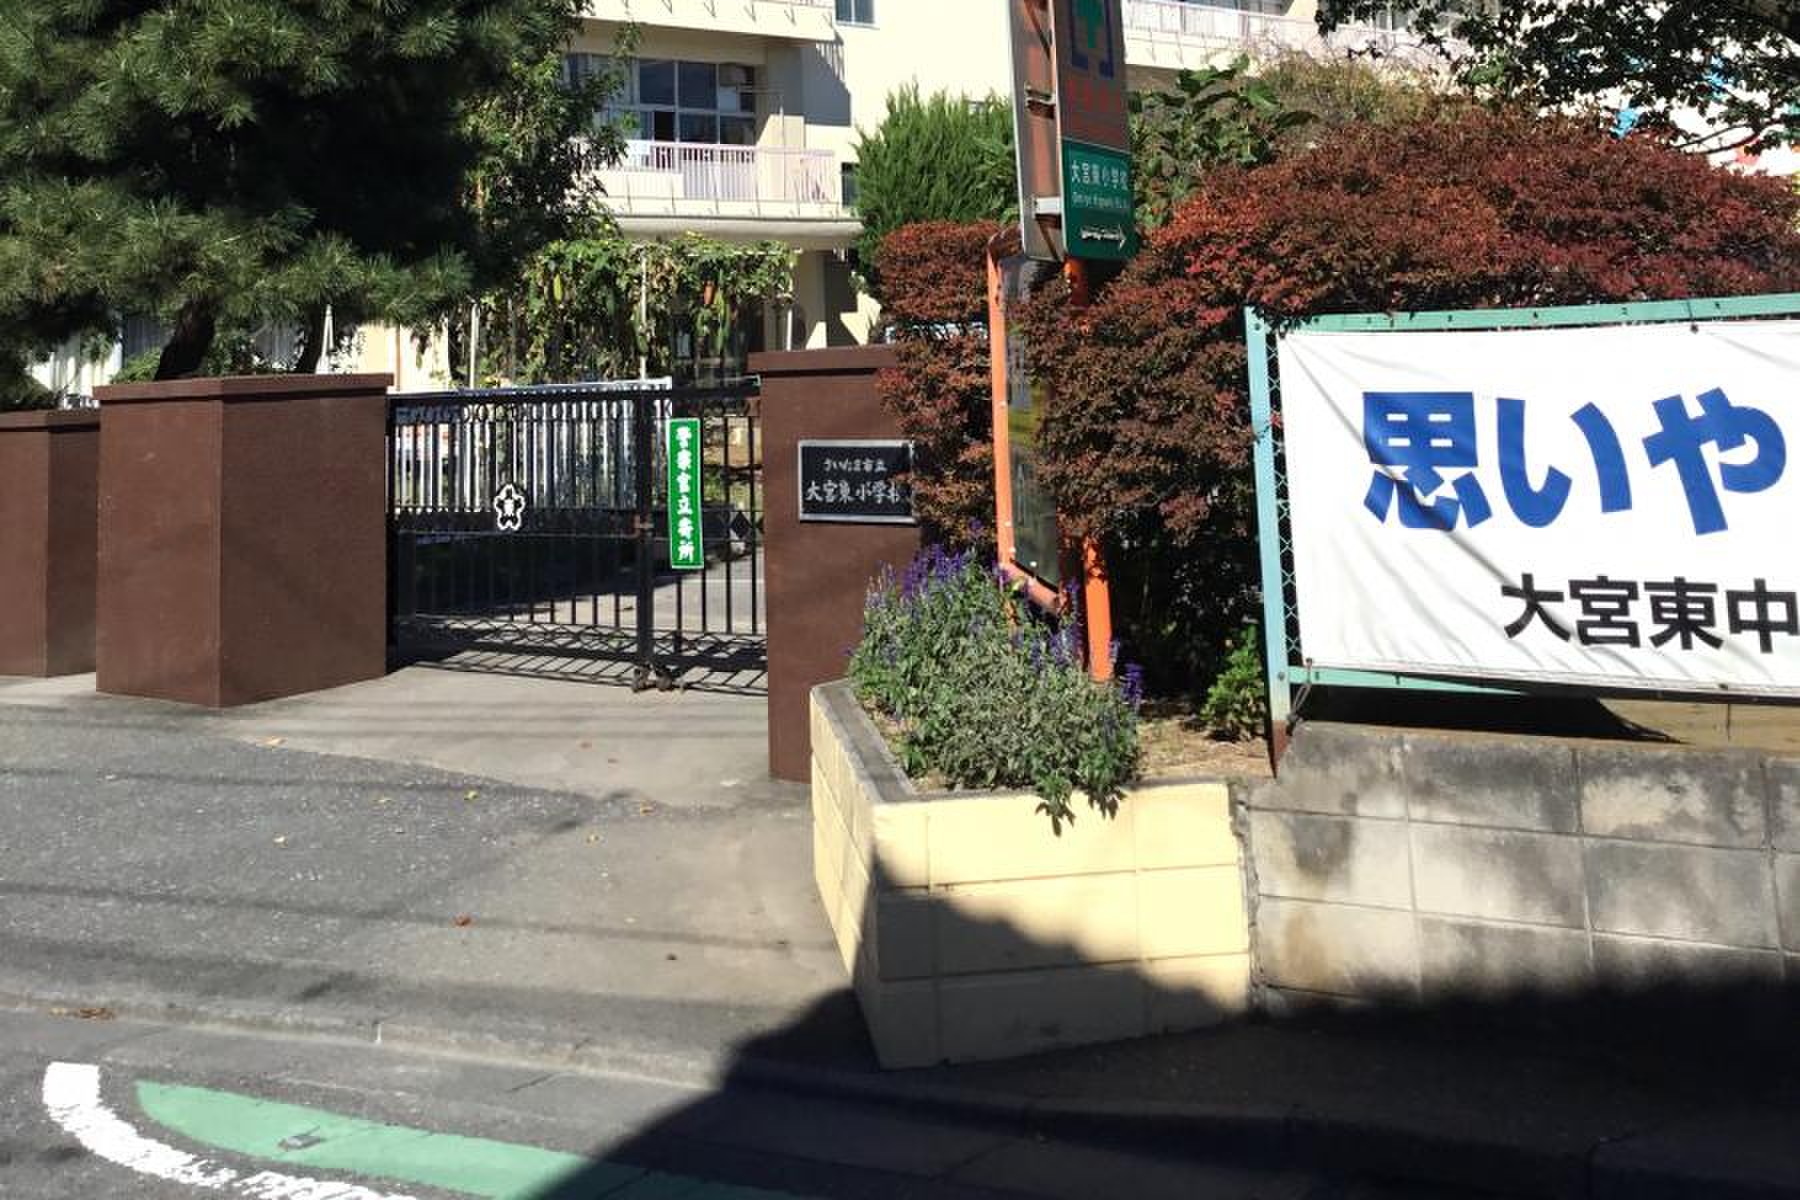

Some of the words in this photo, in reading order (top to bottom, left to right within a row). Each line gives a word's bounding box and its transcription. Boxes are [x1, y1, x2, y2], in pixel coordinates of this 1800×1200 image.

[1363, 387, 1787, 536] 思いや
[1501, 573, 1799, 654] 大宮東中
